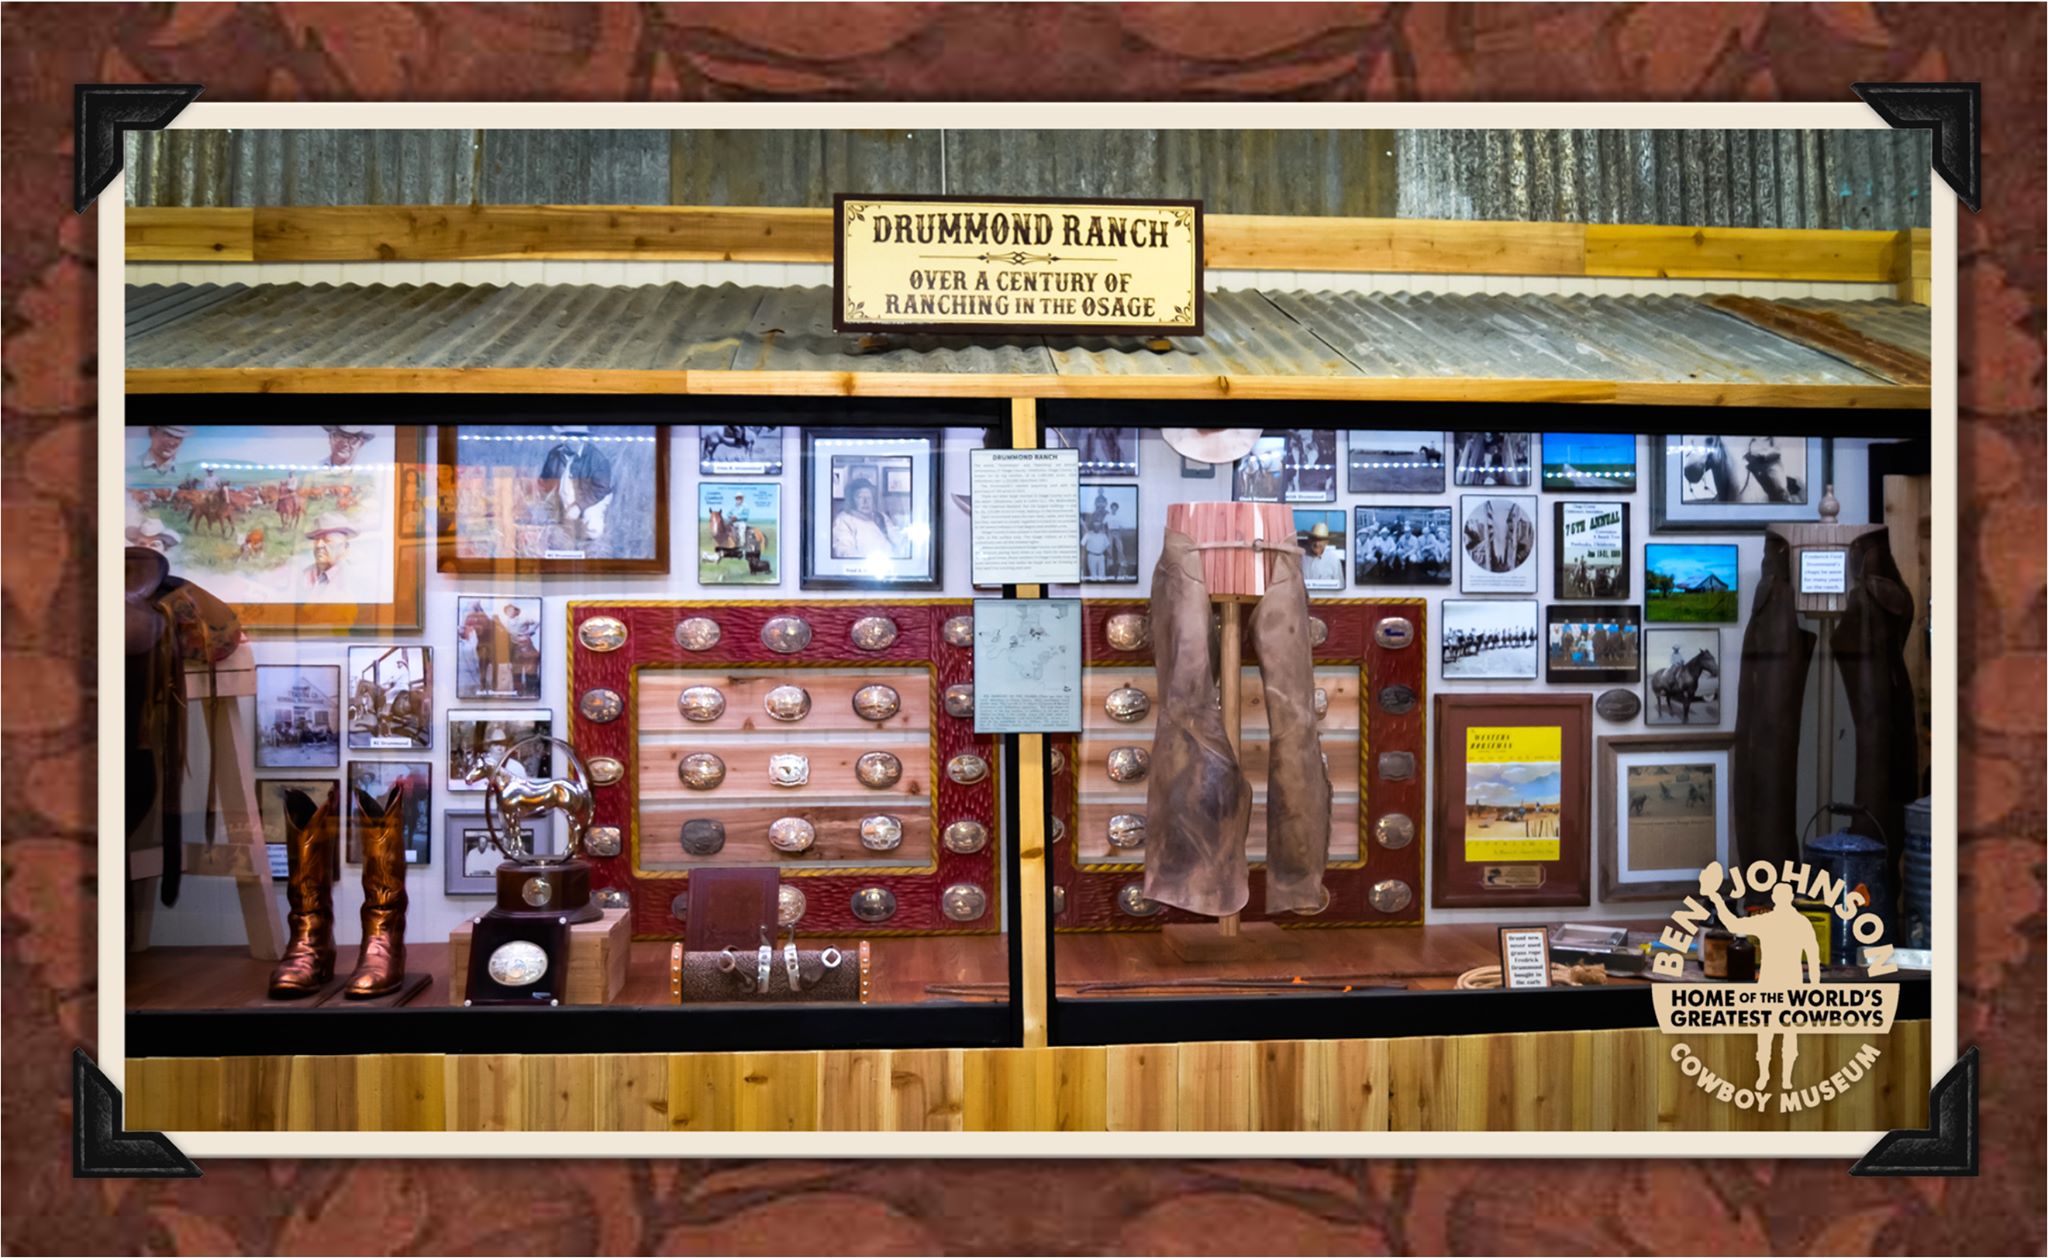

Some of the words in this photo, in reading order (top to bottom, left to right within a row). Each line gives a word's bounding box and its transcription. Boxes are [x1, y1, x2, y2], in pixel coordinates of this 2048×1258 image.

[872, 212, 1053, 246] DRUMMOND
[1062, 214, 1170, 248] RANCH
[909, 269, 968, 291] OVER
[975, 270, 990, 291] A
[996, 271, 1098, 292] CENTURY
[1104, 273, 1133, 293] OF
[885, 294, 1010, 316] RANCHING
[1016, 297, 1035, 315] IN
[1039, 298, 1077, 316] THE
[1082, 297, 1156, 317] OSAGE
[1590, 511, 1620, 530] ANNUAL
